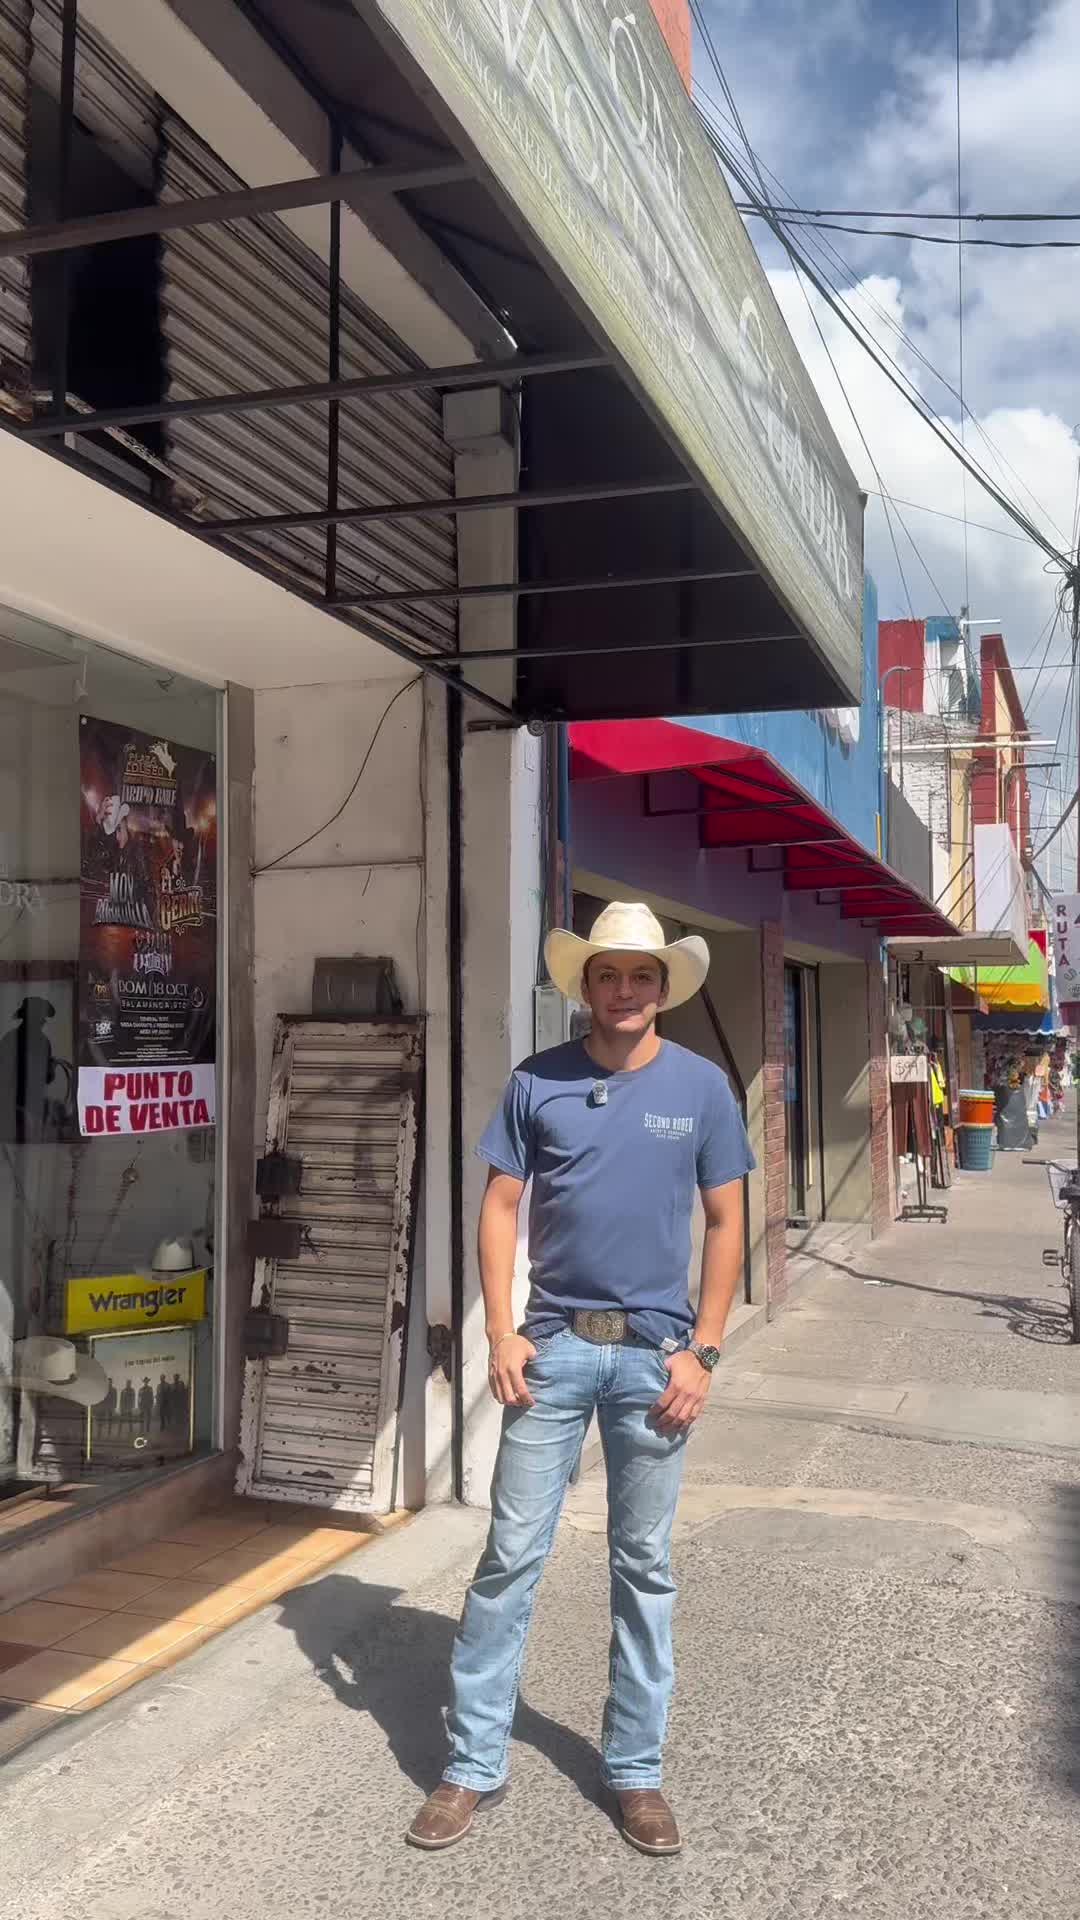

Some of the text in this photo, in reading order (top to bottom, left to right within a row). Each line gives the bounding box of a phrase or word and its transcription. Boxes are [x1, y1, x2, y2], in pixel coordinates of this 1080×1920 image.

[1056, 904, 1070, 967] RUTA
[104, 1070, 193, 1101] PUNTO
[85, 1098, 210, 1133] DE VENTA
[644, 1112, 671, 1129] SECOND
[672, 1117, 693, 1133] RODEO
[88, 1286, 187, 1318] Wrangler
